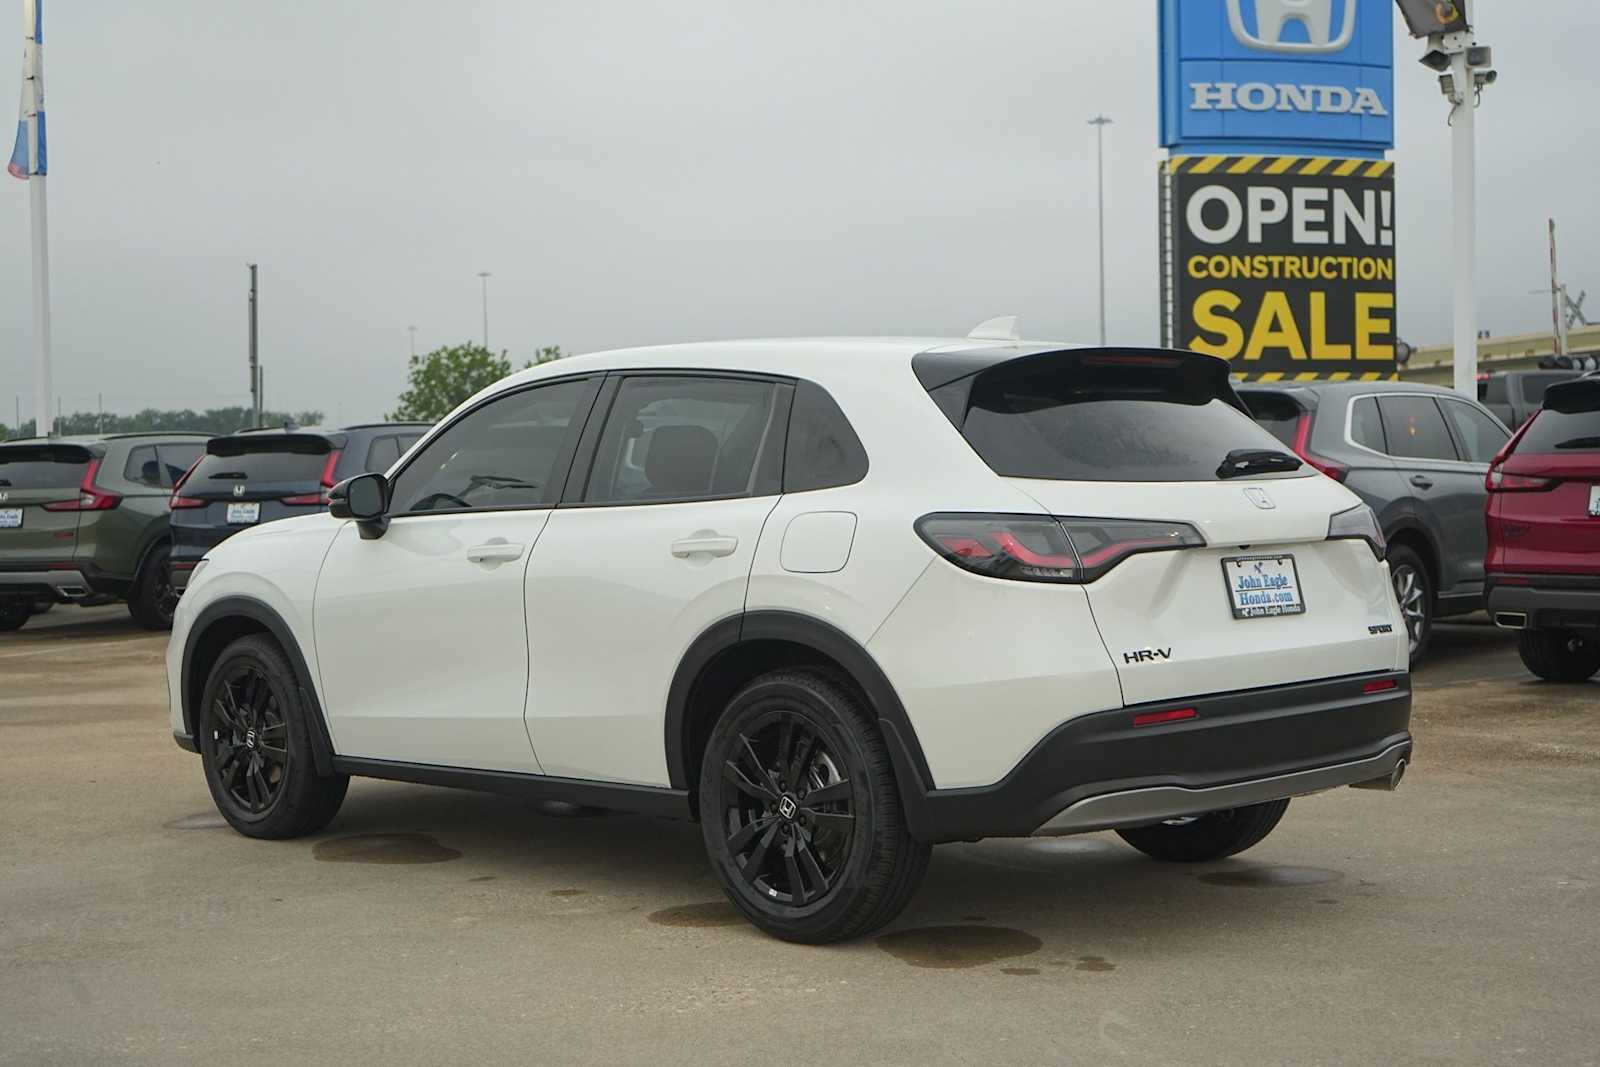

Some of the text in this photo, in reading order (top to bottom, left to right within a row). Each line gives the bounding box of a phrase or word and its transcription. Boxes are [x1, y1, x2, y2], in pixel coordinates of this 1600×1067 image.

[1189, 82, 1389, 116] HONDA
[1186, 184, 1393, 246] OPEN!
[1187, 255, 1393, 280] CONSTRUCTION
[1188, 289, 1394, 361] SALE
[1238, 573, 1288, 589] John Eagle
[1239, 591, 1294, 606] Honda.com
[1123, 647, 1172, 664] HR-V
